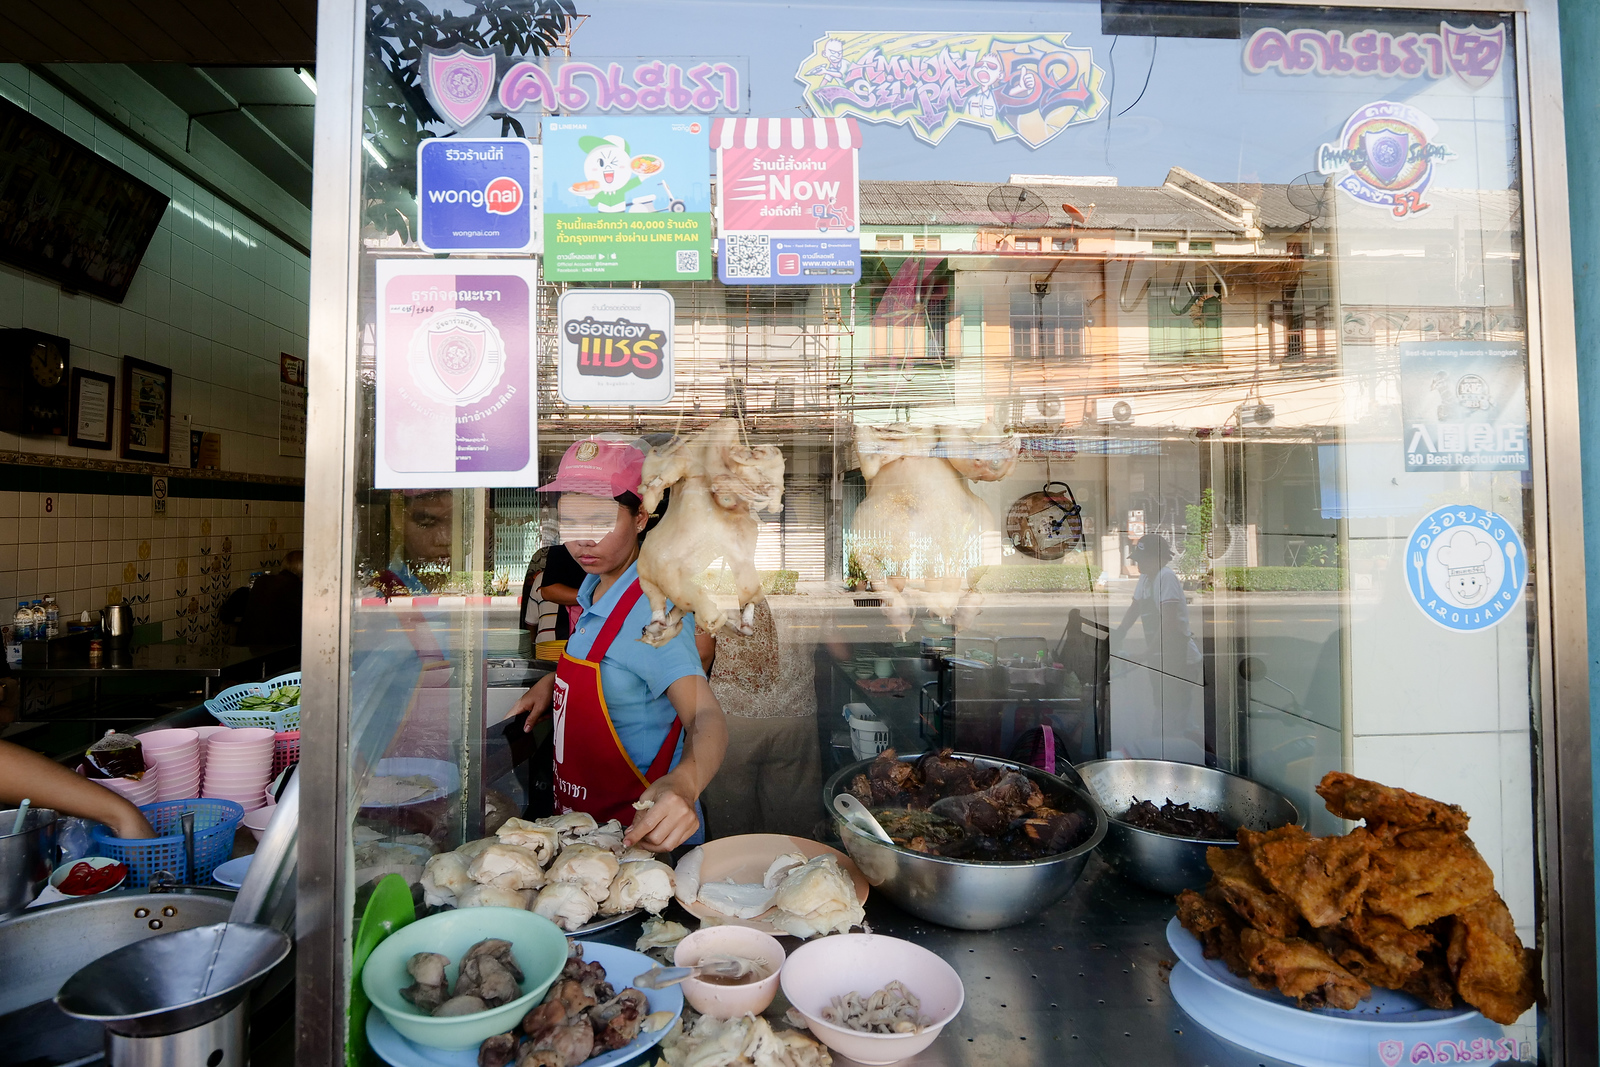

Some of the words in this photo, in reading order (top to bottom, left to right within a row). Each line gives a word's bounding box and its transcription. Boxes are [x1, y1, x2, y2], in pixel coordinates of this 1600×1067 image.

[1451, 34, 1501, 77] 52
[996, 44, 1091, 112] 52
[446, 145, 504, 161] รีวิวร้านนี้ที่
[752, 154, 827, 171] ร้านนี้สั่งผ่าน
[427, 186, 517, 208] wongnai
[768, 174, 841, 201] Now
[759, 202, 802, 217] ส่งถึงที่!
[1393, 191, 1431, 217] 52
[556, 217, 628, 230] ร้านนี้และอีกกว่า
[630, 220, 665, 231] 40,000
[667, 218, 699, 230] ร้านดัง
[452, 230, 500, 238] wongnai.com
[556, 230, 613, 245] ทั่วกรุงเทพฯ
[615, 232, 648, 243] ส่งผ่าน
[650, 233, 673, 242] LINE
[674, 233, 699, 242] MAN
[802, 259, 855, 267] www.now.in.th
[411, 285, 501, 306] ธุรกิจคณะเรา
[567, 319, 646, 338] อร่อยต้อง
[580, 333, 661, 370] แชร์
[1437, 349, 1458, 357] Dining
[1459, 349, 1484, 357] Awards
[1488, 349, 1518, 357] Bangkok
[1407, 422, 1525, 453] 入圍食店
[1408, 453, 1424, 465] 30
[1426, 453, 1453, 465] Best
[1455, 452, 1526, 465] Restaurants
[45, 497, 53, 513] 8
[1416, 510, 1507, 551] อร่อยจัง
[1427, 590, 1513, 625] AROIJANG
